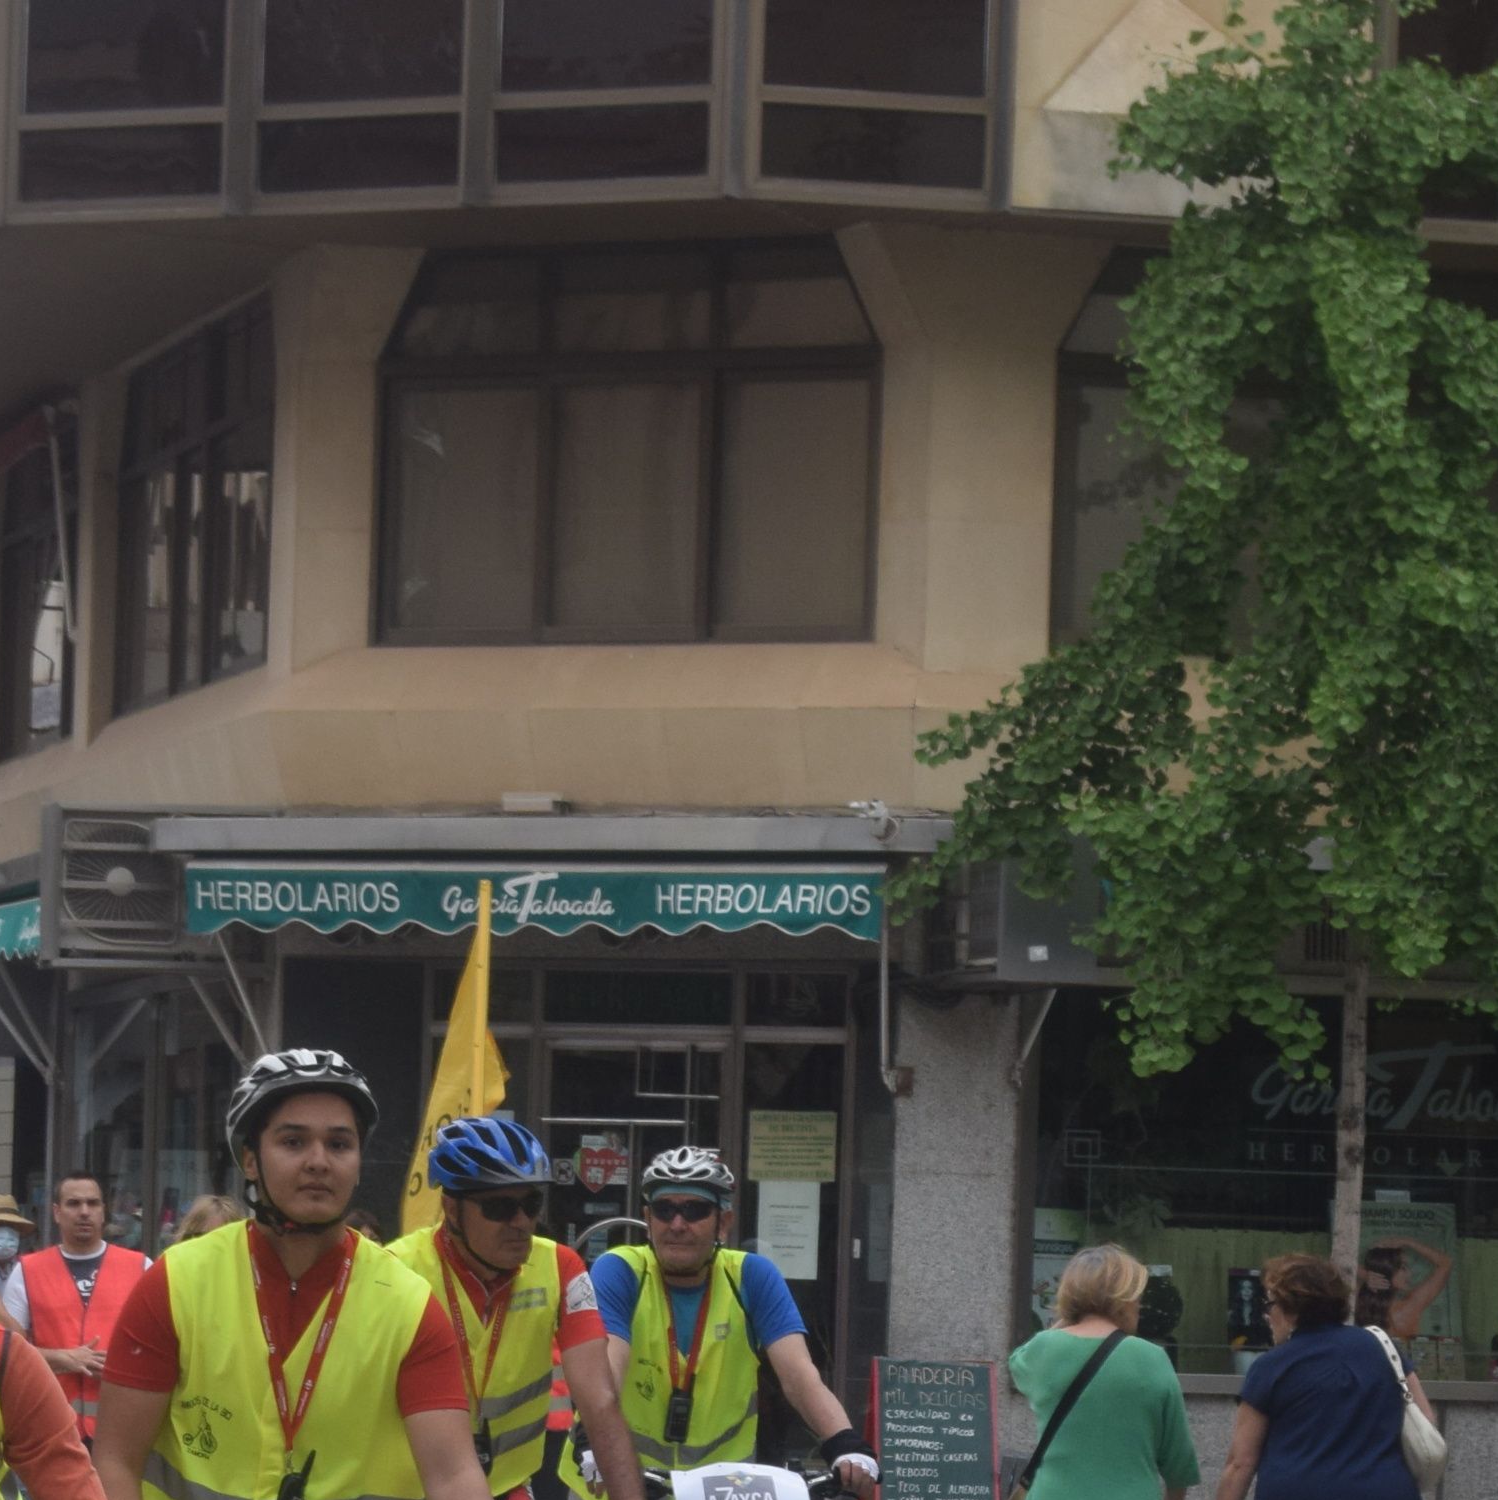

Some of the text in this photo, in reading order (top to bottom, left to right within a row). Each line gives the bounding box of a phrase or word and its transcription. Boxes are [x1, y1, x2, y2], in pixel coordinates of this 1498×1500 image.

[195, 881, 401, 914] HERBOLARIOS
[504, 872, 615, 923] Taboada
[656, 883, 871, 916] HERBOLARIOS
[1251, 1060, 1394, 1120] Gara
[885, 1409, 951, 1420] ESPECIALIDAD
[885, 1421, 935, 1435] PRODUCTOS
[894, 1452, 979, 1463] ACEITADAS CASERAS
[895, 1466, 939, 1477] REBOJOS
